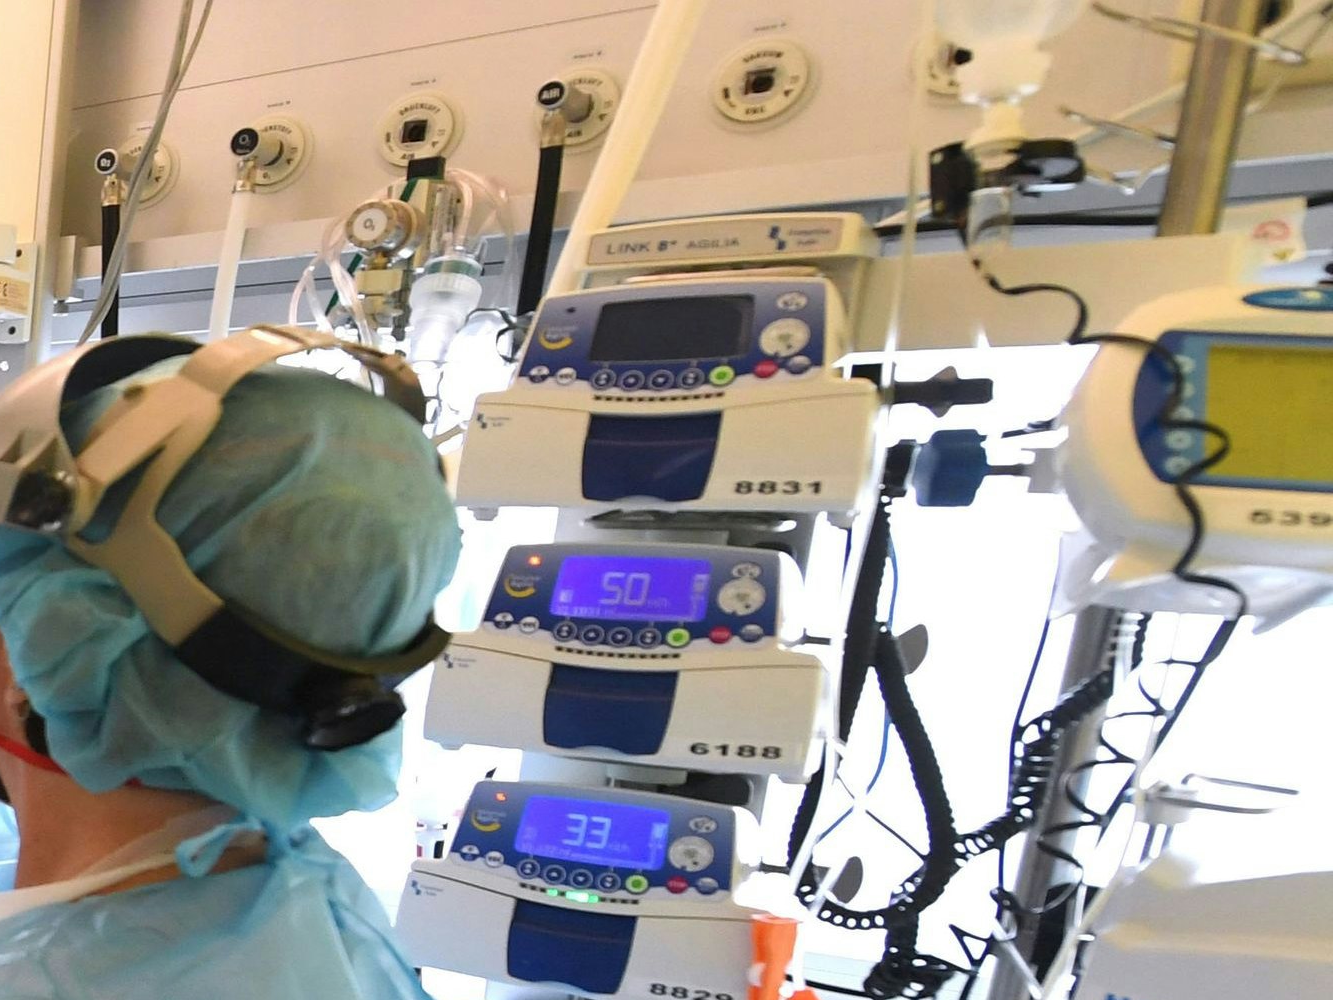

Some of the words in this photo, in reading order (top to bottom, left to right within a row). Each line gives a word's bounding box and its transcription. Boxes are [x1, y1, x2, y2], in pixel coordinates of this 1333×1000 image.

[605, 240, 651, 256] LINK
[733, 479, 824, 496] 8831
[689, 742, 783, 760] 6188
[561, 812, 612, 850] 33
